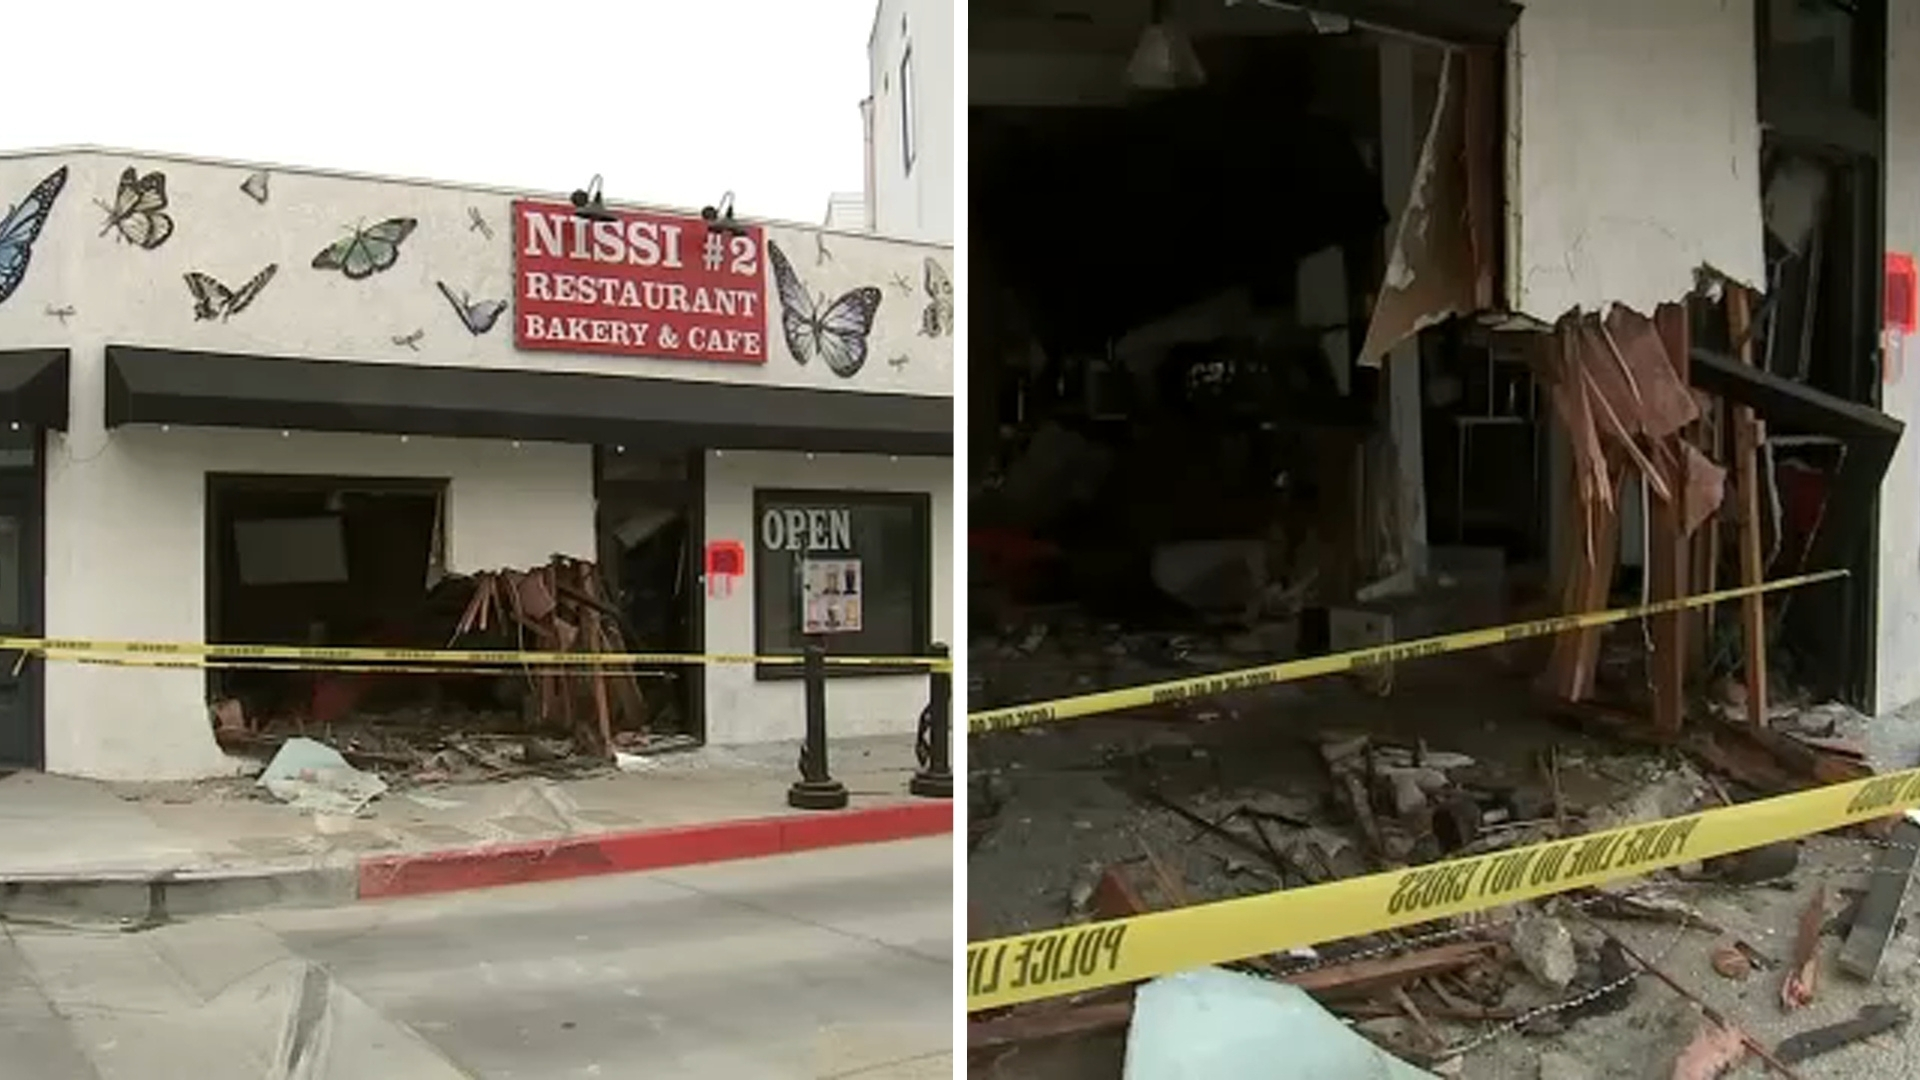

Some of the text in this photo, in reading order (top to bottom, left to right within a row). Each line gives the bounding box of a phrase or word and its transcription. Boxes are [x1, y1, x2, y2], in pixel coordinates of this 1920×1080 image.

[523, 212, 757, 275] NISSI #2
[525, 271, 757, 317] RESTAURANT
[525, 314, 760, 355] BAKERY & CAFE
[763, 509, 850, 550] OPEN
